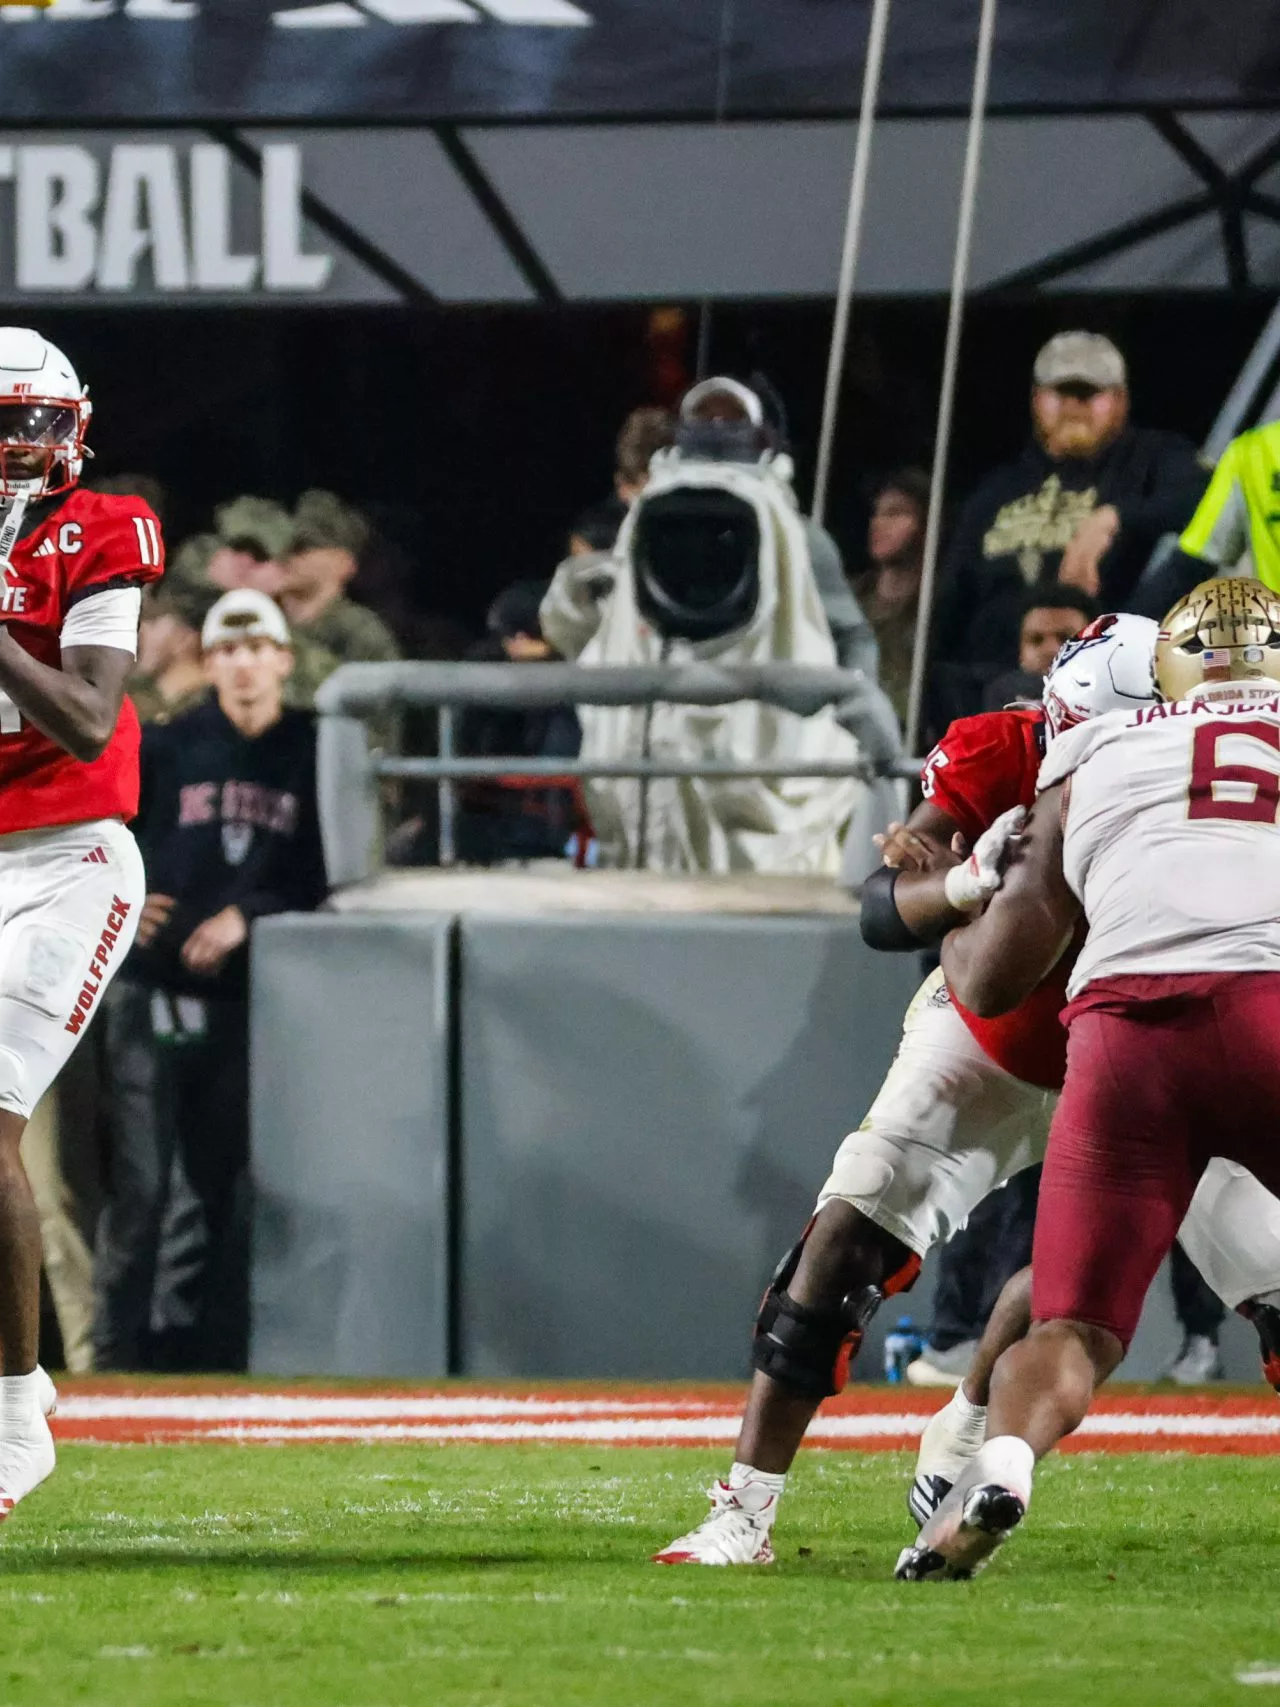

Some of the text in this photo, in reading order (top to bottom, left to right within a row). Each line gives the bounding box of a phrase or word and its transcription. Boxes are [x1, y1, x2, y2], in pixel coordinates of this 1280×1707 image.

[59, 522, 82, 553] C
[132, 517, 160, 566] 11
[1185, 719, 1280, 825] 6
[64, 894, 131, 1036] WOLFPACK
